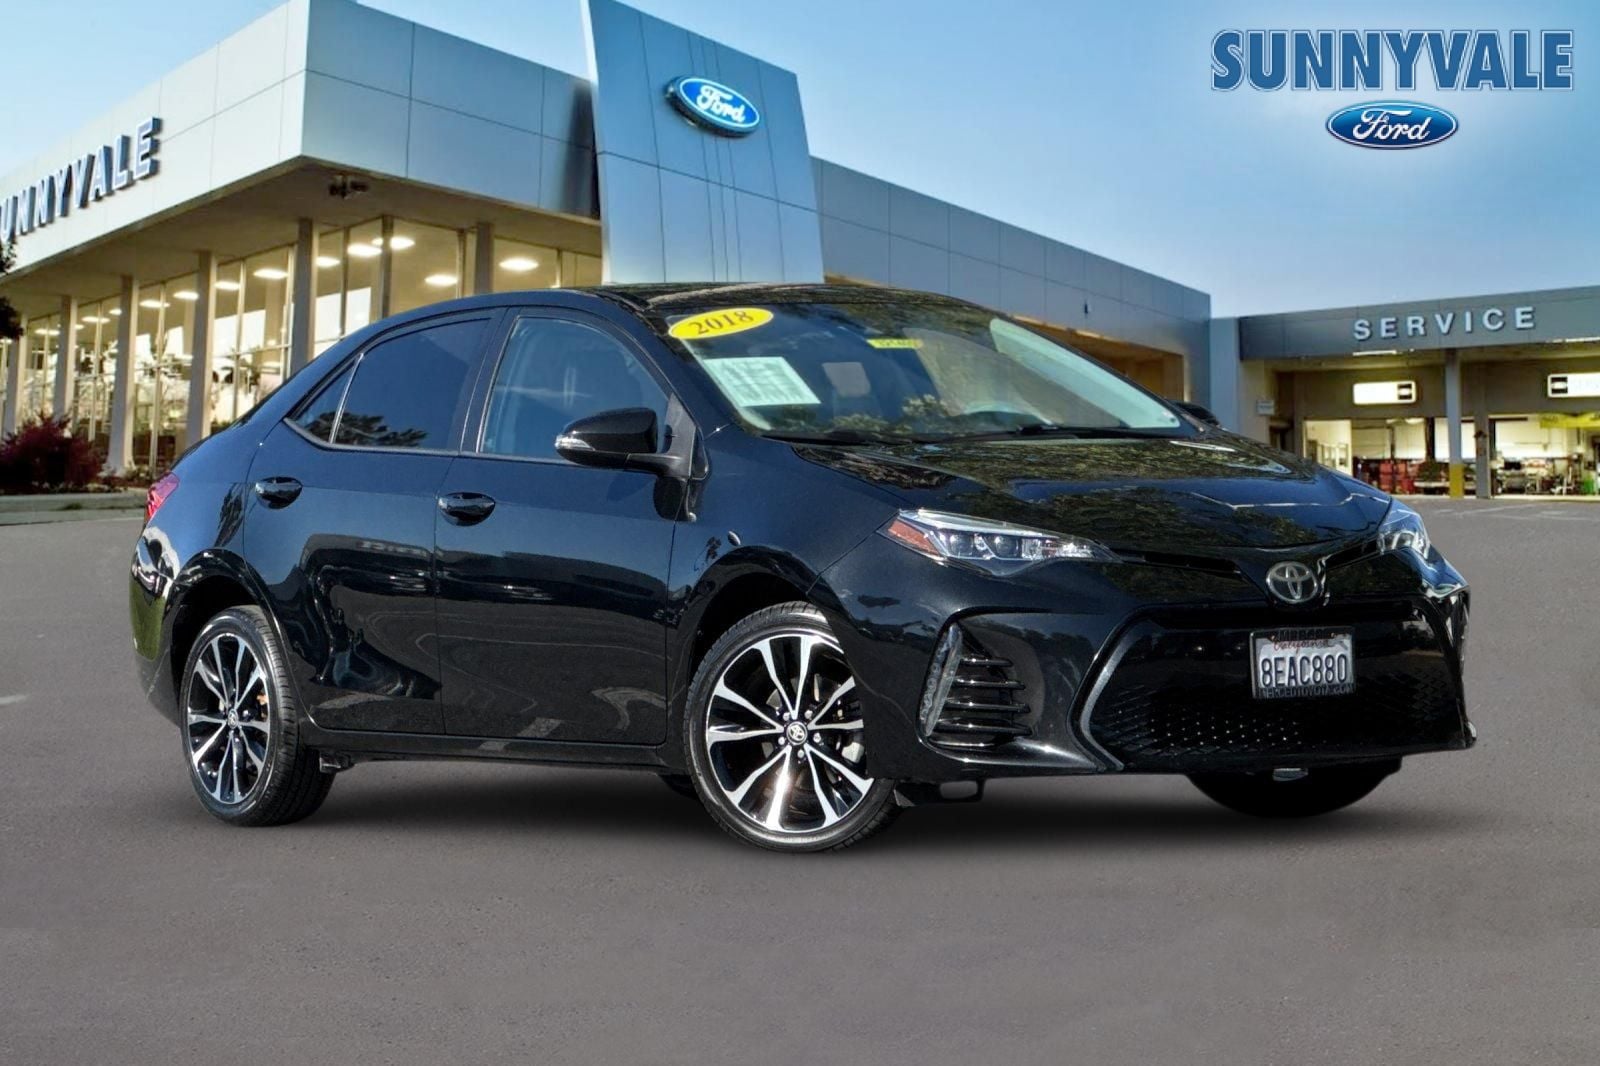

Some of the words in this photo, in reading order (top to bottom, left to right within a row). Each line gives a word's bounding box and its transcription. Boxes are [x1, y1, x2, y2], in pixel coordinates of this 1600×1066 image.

[697, 85, 746, 122] Ford
[0, 116, 162, 244] UNNYVALE
[690, 310, 754, 335] 2018
[1353, 306, 1536, 341] SERVICE
[1261, 653, 1348, 688] 8EAC880
